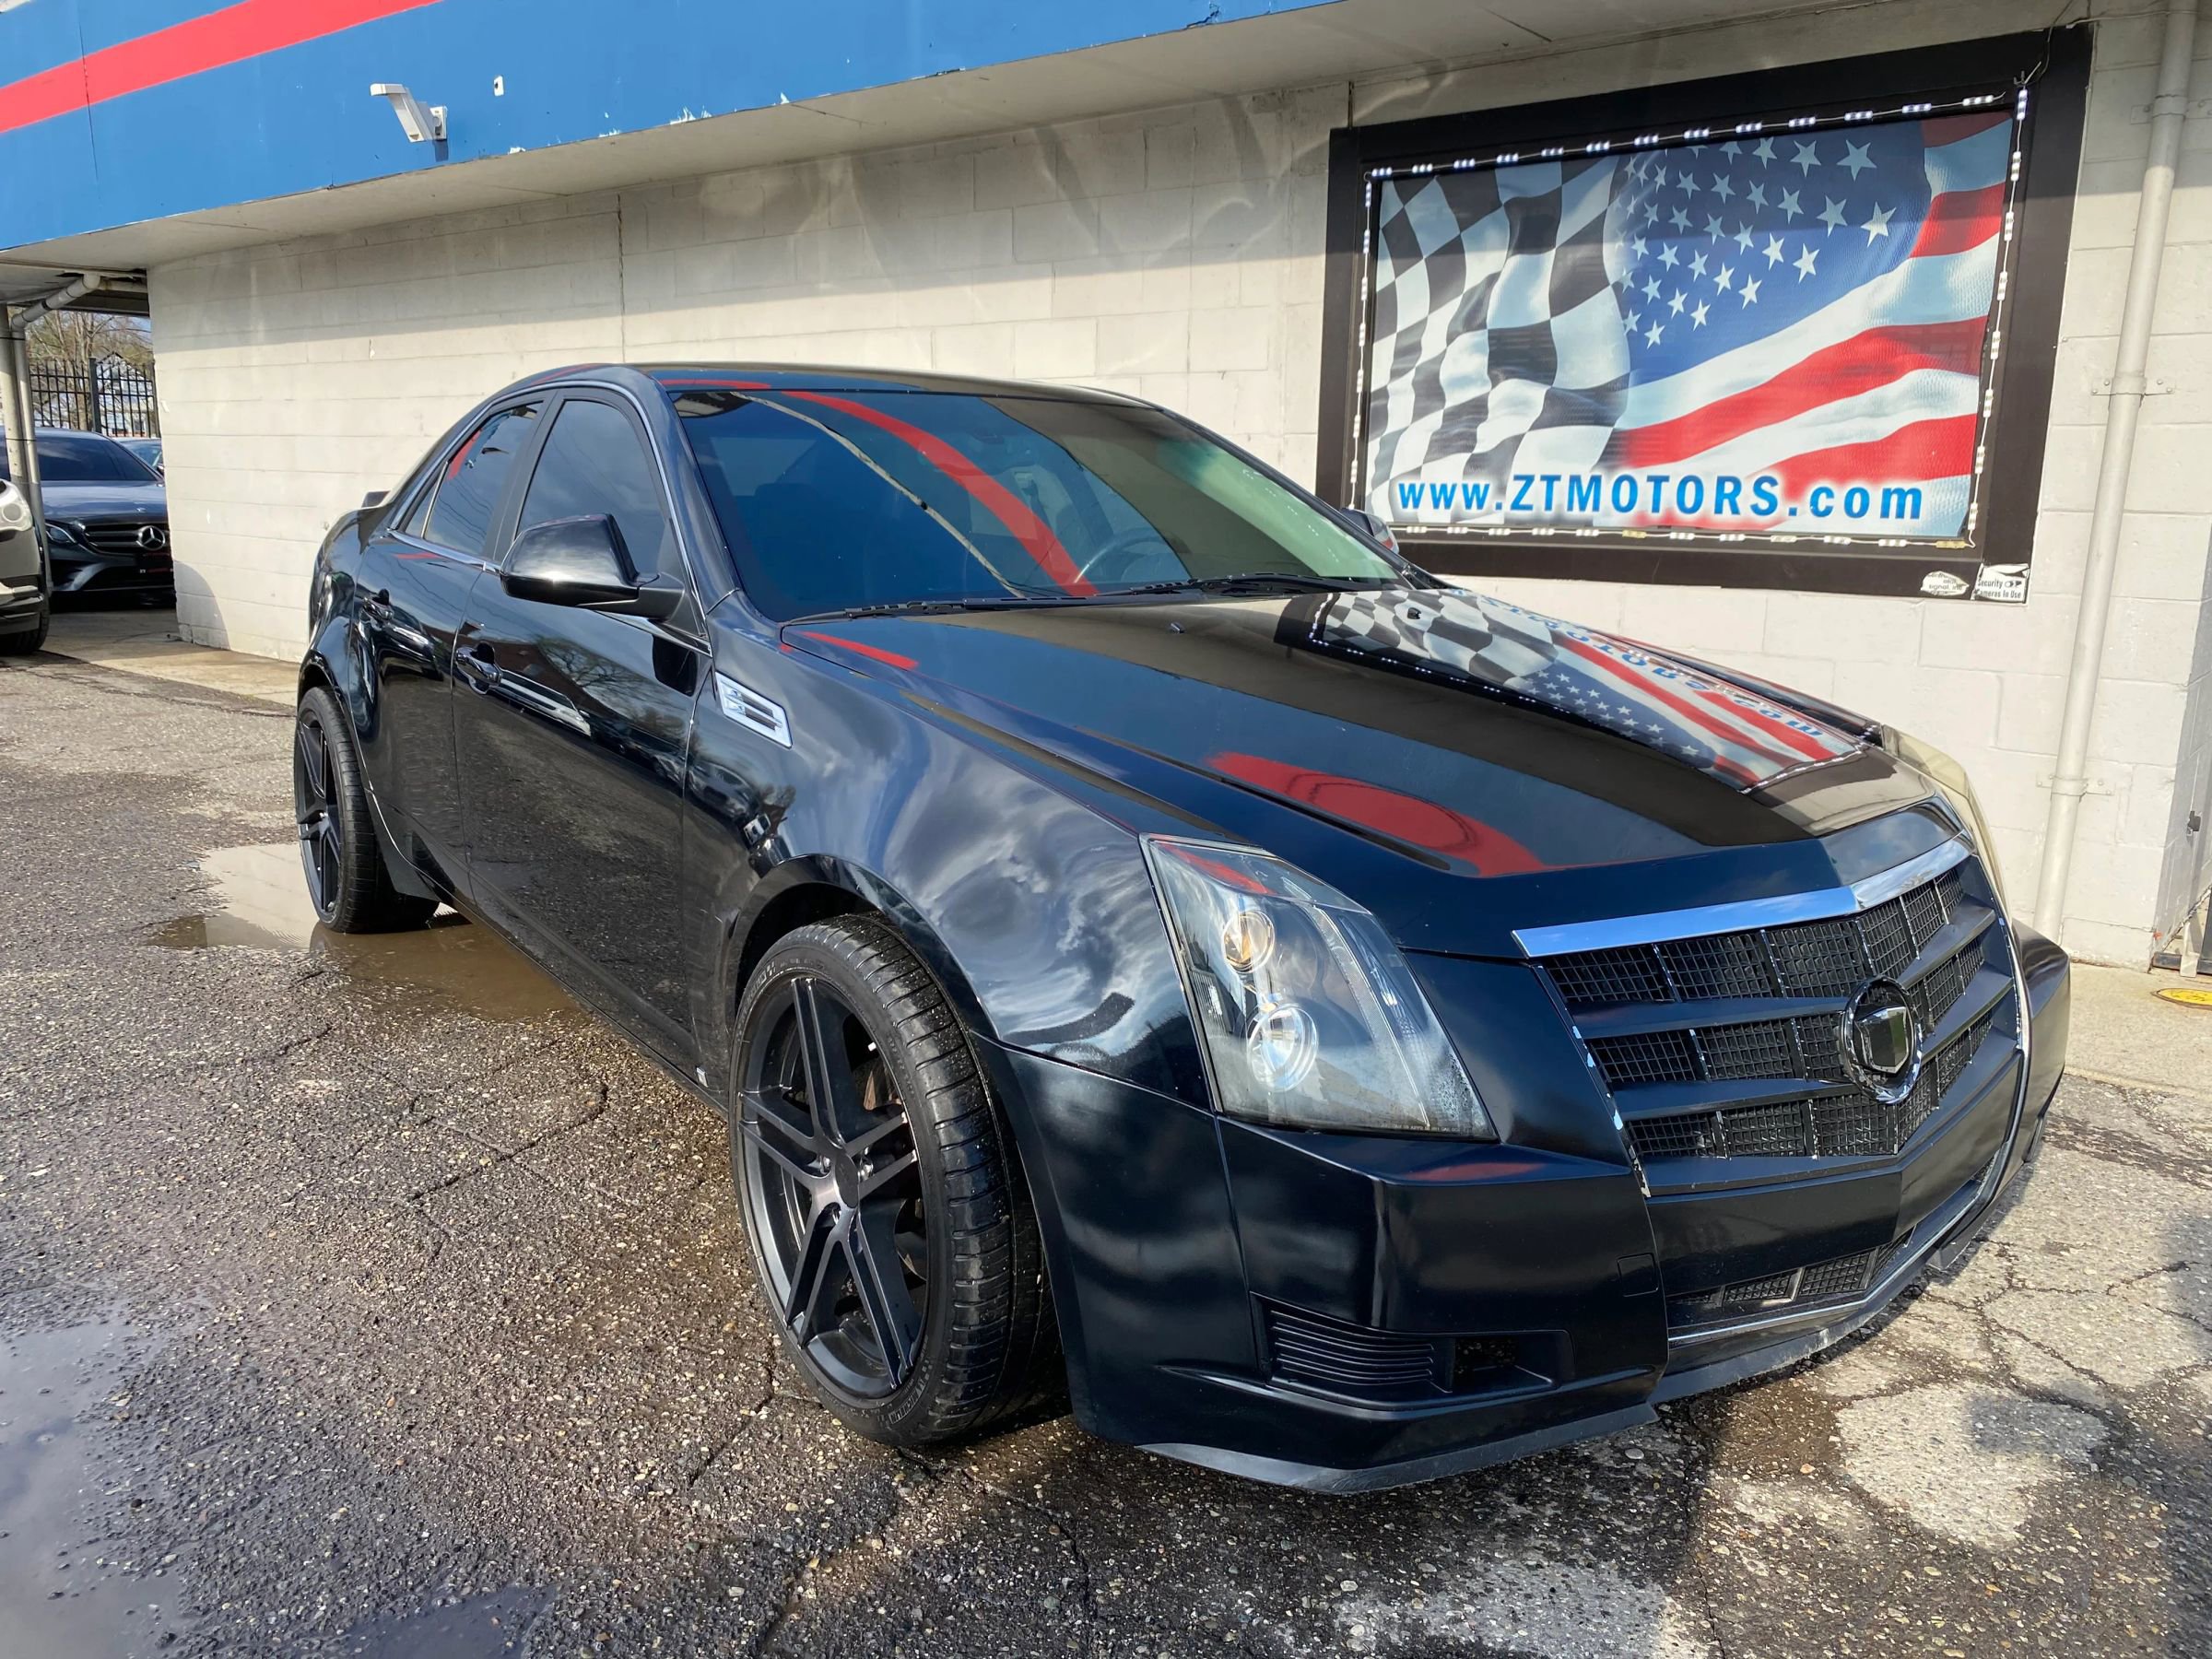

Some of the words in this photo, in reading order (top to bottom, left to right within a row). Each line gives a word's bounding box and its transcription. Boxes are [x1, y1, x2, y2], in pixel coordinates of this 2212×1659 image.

[1398, 474, 1923, 520] www.ZTMOTORS.com
[1977, 578, 2003, 589] Security
[2011, 590, 2021, 599] Use
